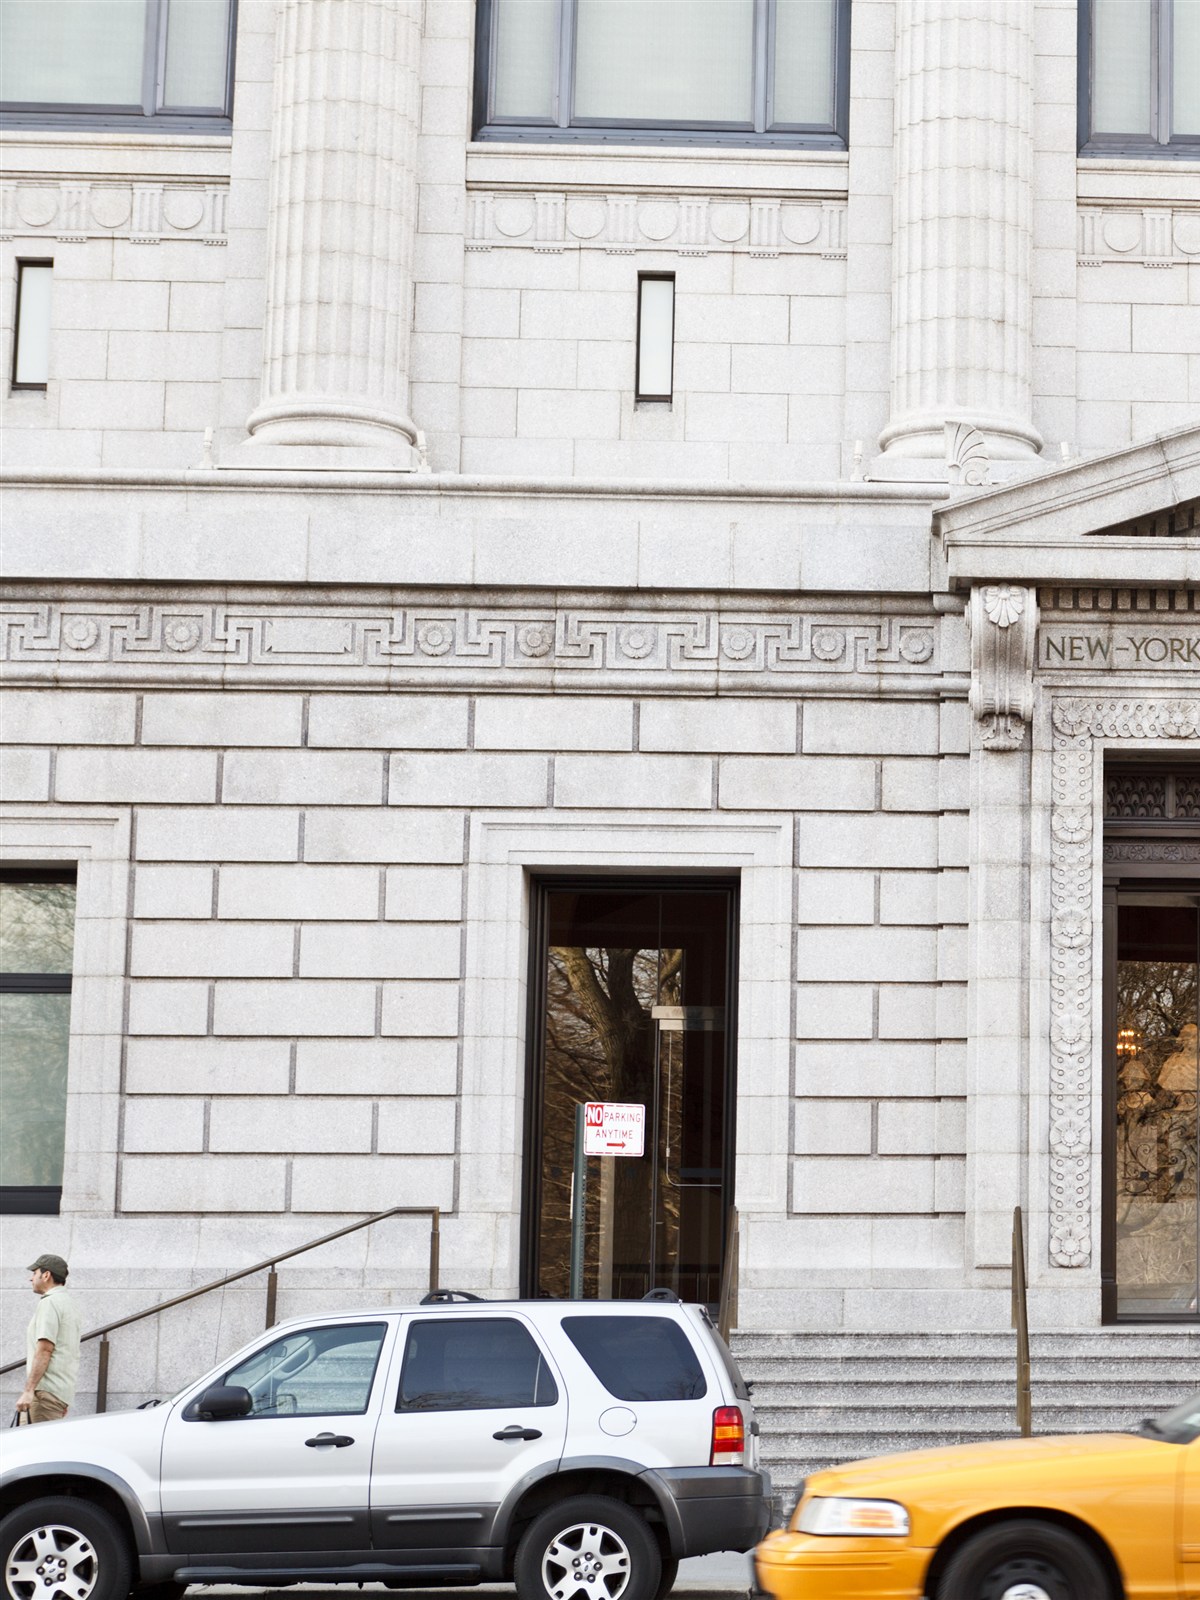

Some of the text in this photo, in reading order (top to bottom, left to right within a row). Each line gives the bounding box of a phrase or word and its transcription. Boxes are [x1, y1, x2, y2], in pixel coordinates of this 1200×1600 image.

[587, 1107, 641, 1124] NO PARKING
[595, 1129, 633, 1140] ANYTIME
